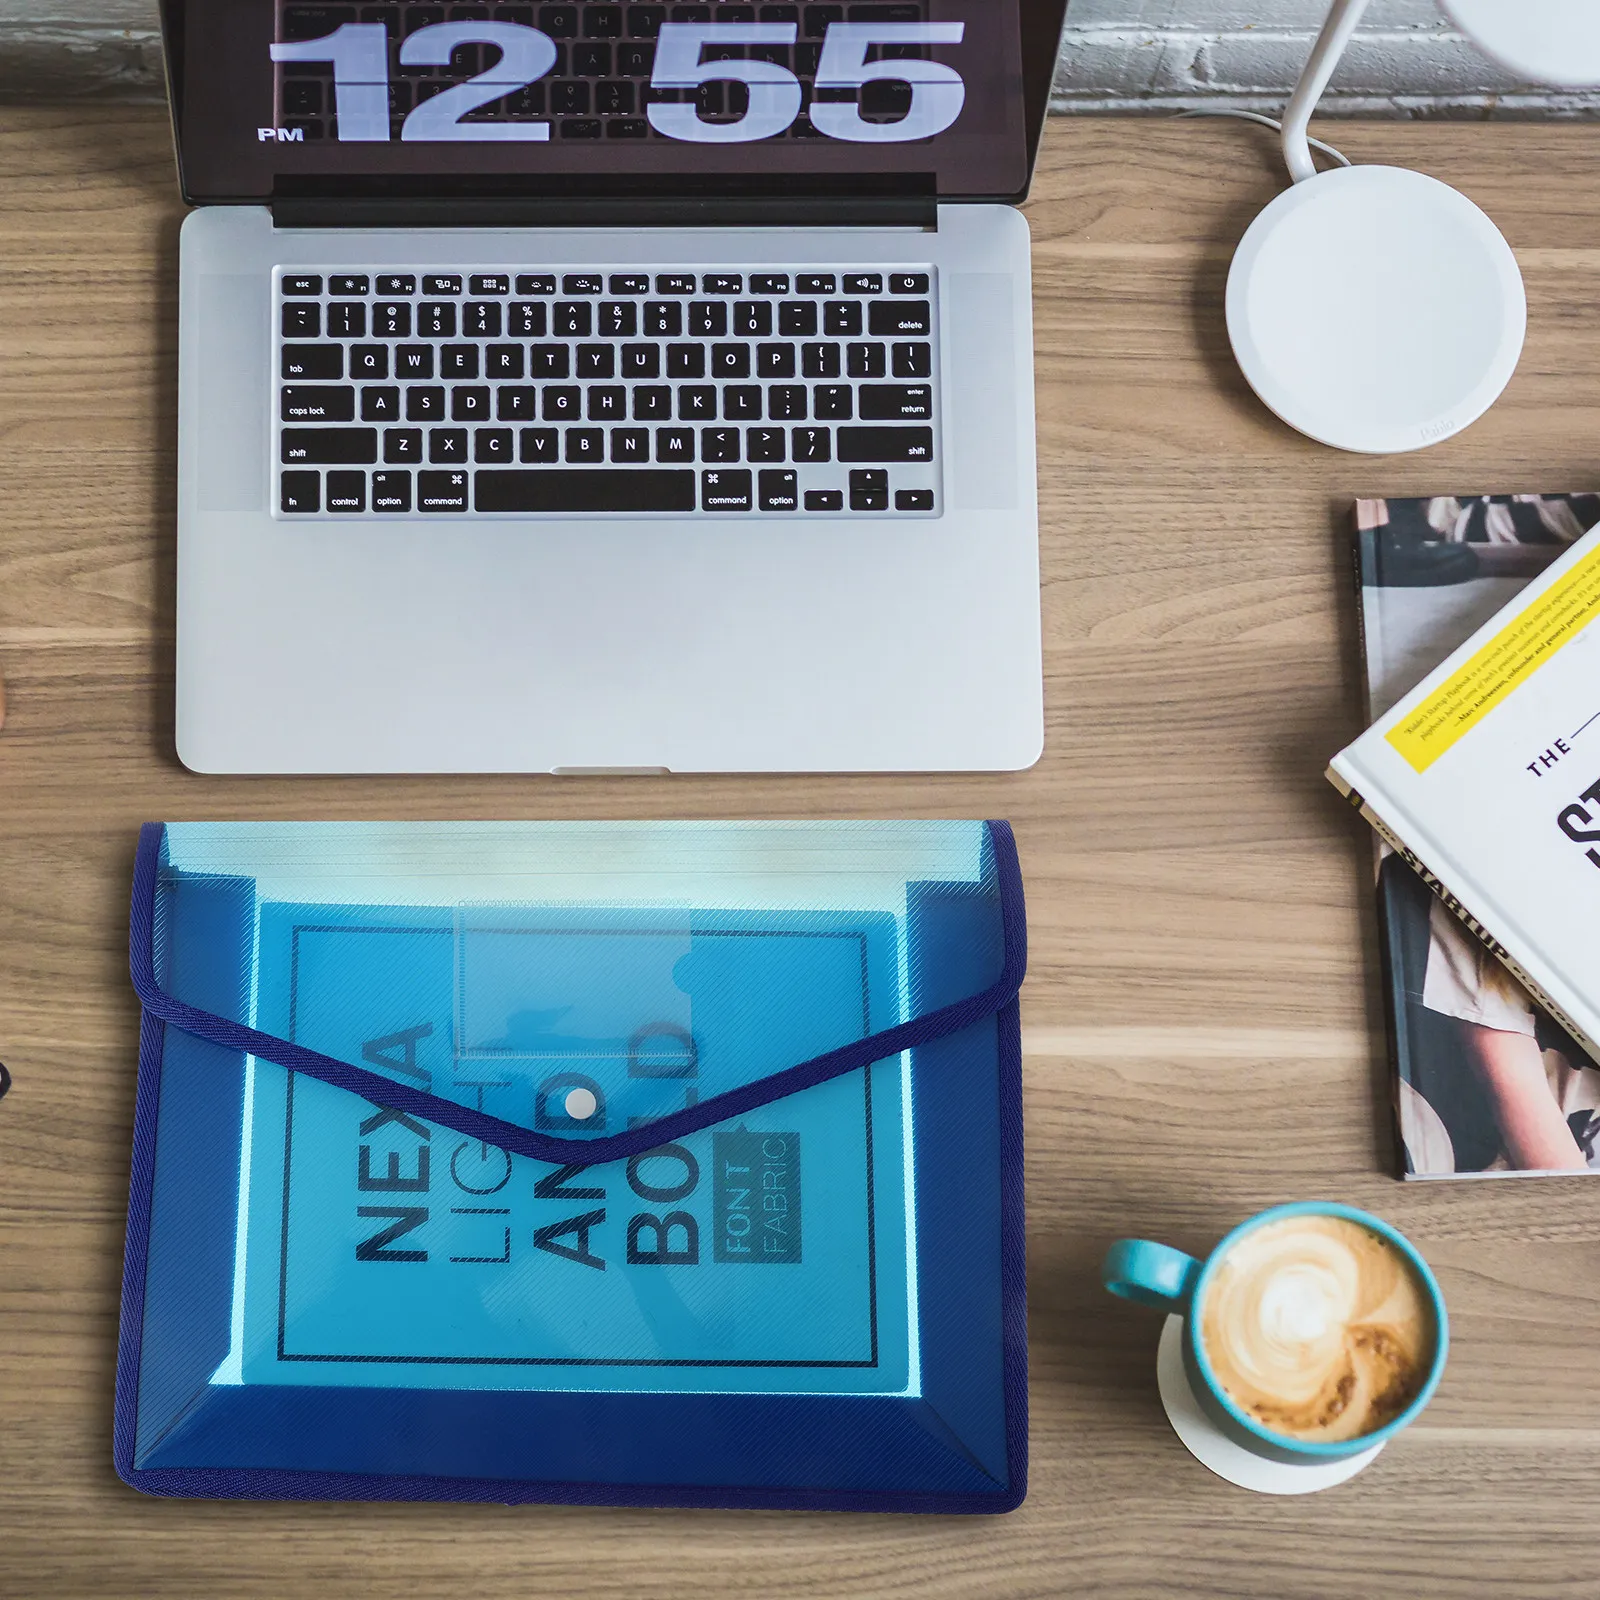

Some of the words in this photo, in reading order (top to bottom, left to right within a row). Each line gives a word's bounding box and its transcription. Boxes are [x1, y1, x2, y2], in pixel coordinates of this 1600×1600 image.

[270, 22, 555, 142] 12
[647, 21, 964, 142] 55
[257, 128, 304, 142] PM
[344, 306, 349, 317] !
[386, 306, 398, 317] @
[432, 306, 442, 317] #
[478, 305, 486, 317] $
[521, 305, 533, 317] %
[612, 305, 623, 317] &
[706, 305, 711, 316] (
[750, 305, 755, 316] )
[839, 305, 848, 314] +
[343, 319, 350, 331] 1
[387, 319, 396, 331] 2
[432, 319, 441, 332] 3
[477, 319, 487, 331] 4
[523, 319, 532, 331] 5
[568, 319, 577, 331] 6
[613, 319, 622, 331] 7
[658, 319, 667, 330] 8
[703, 319, 713, 330] 9
[748, 318, 758, 330] 0
[897, 320, 923, 330] delete
[363, 354, 376, 367] Q
[407, 354, 421, 367] W
[456, 354, 464, 367] E
[501, 354, 510, 367] R
[546, 354, 555, 366] T
[591, 354, 601, 366] Y
[635, 353, 646, 366] U
[683, 353, 689, 366] I
[725, 353, 737, 366] O
[772, 353, 781, 365] P
[289, 364, 304, 373] tab
[907, 360, 915, 372] \
[906, 388, 925, 396] enter
[375, 396, 386, 409] A
[421, 396, 431, 409] S
[466, 396, 477, 409] D
[513, 396, 521, 409] F
[556, 396, 568, 409] G
[602, 396, 613, 409] H
[648, 396, 656, 408] J
[693, 395, 703, 408] K
[739, 395, 748, 408] L
[288, 407, 307, 416] caps
[309, 406, 326, 415] lock
[900, 405, 925, 414] return
[716, 433, 725, 442] <
[762, 432, 771, 441] >
[807, 430, 816, 442] ?
[398, 438, 409, 451] Z
[443, 438, 455, 451] X
[489, 438, 500, 451] C
[534, 438, 545, 451] V
[580, 438, 590, 451] B
[625, 437, 636, 450] N
[669, 437, 683, 450] M
[288, 448, 307, 458] shift
[808, 445, 815, 456] /
[907, 446, 926, 456] shift
[376, 474, 386, 482] alt
[783, 473, 793, 481] alt
[288, 497, 298, 506] fn
[331, 497, 359, 506] control
[376, 496, 402, 507] option
[423, 496, 463, 506] command
[707, 495, 747, 505] command
[768, 496, 794, 506] option
[1543, 623, 1568, 646] general
[1444, 674, 1472, 700] Playbook
[1525, 737, 1572, 778] THE
[1400, 846, 1511, 961] STARTUP
[762, 1138, 787, 1253] FABRIC
[725, 1159, 751, 1253] FONT
